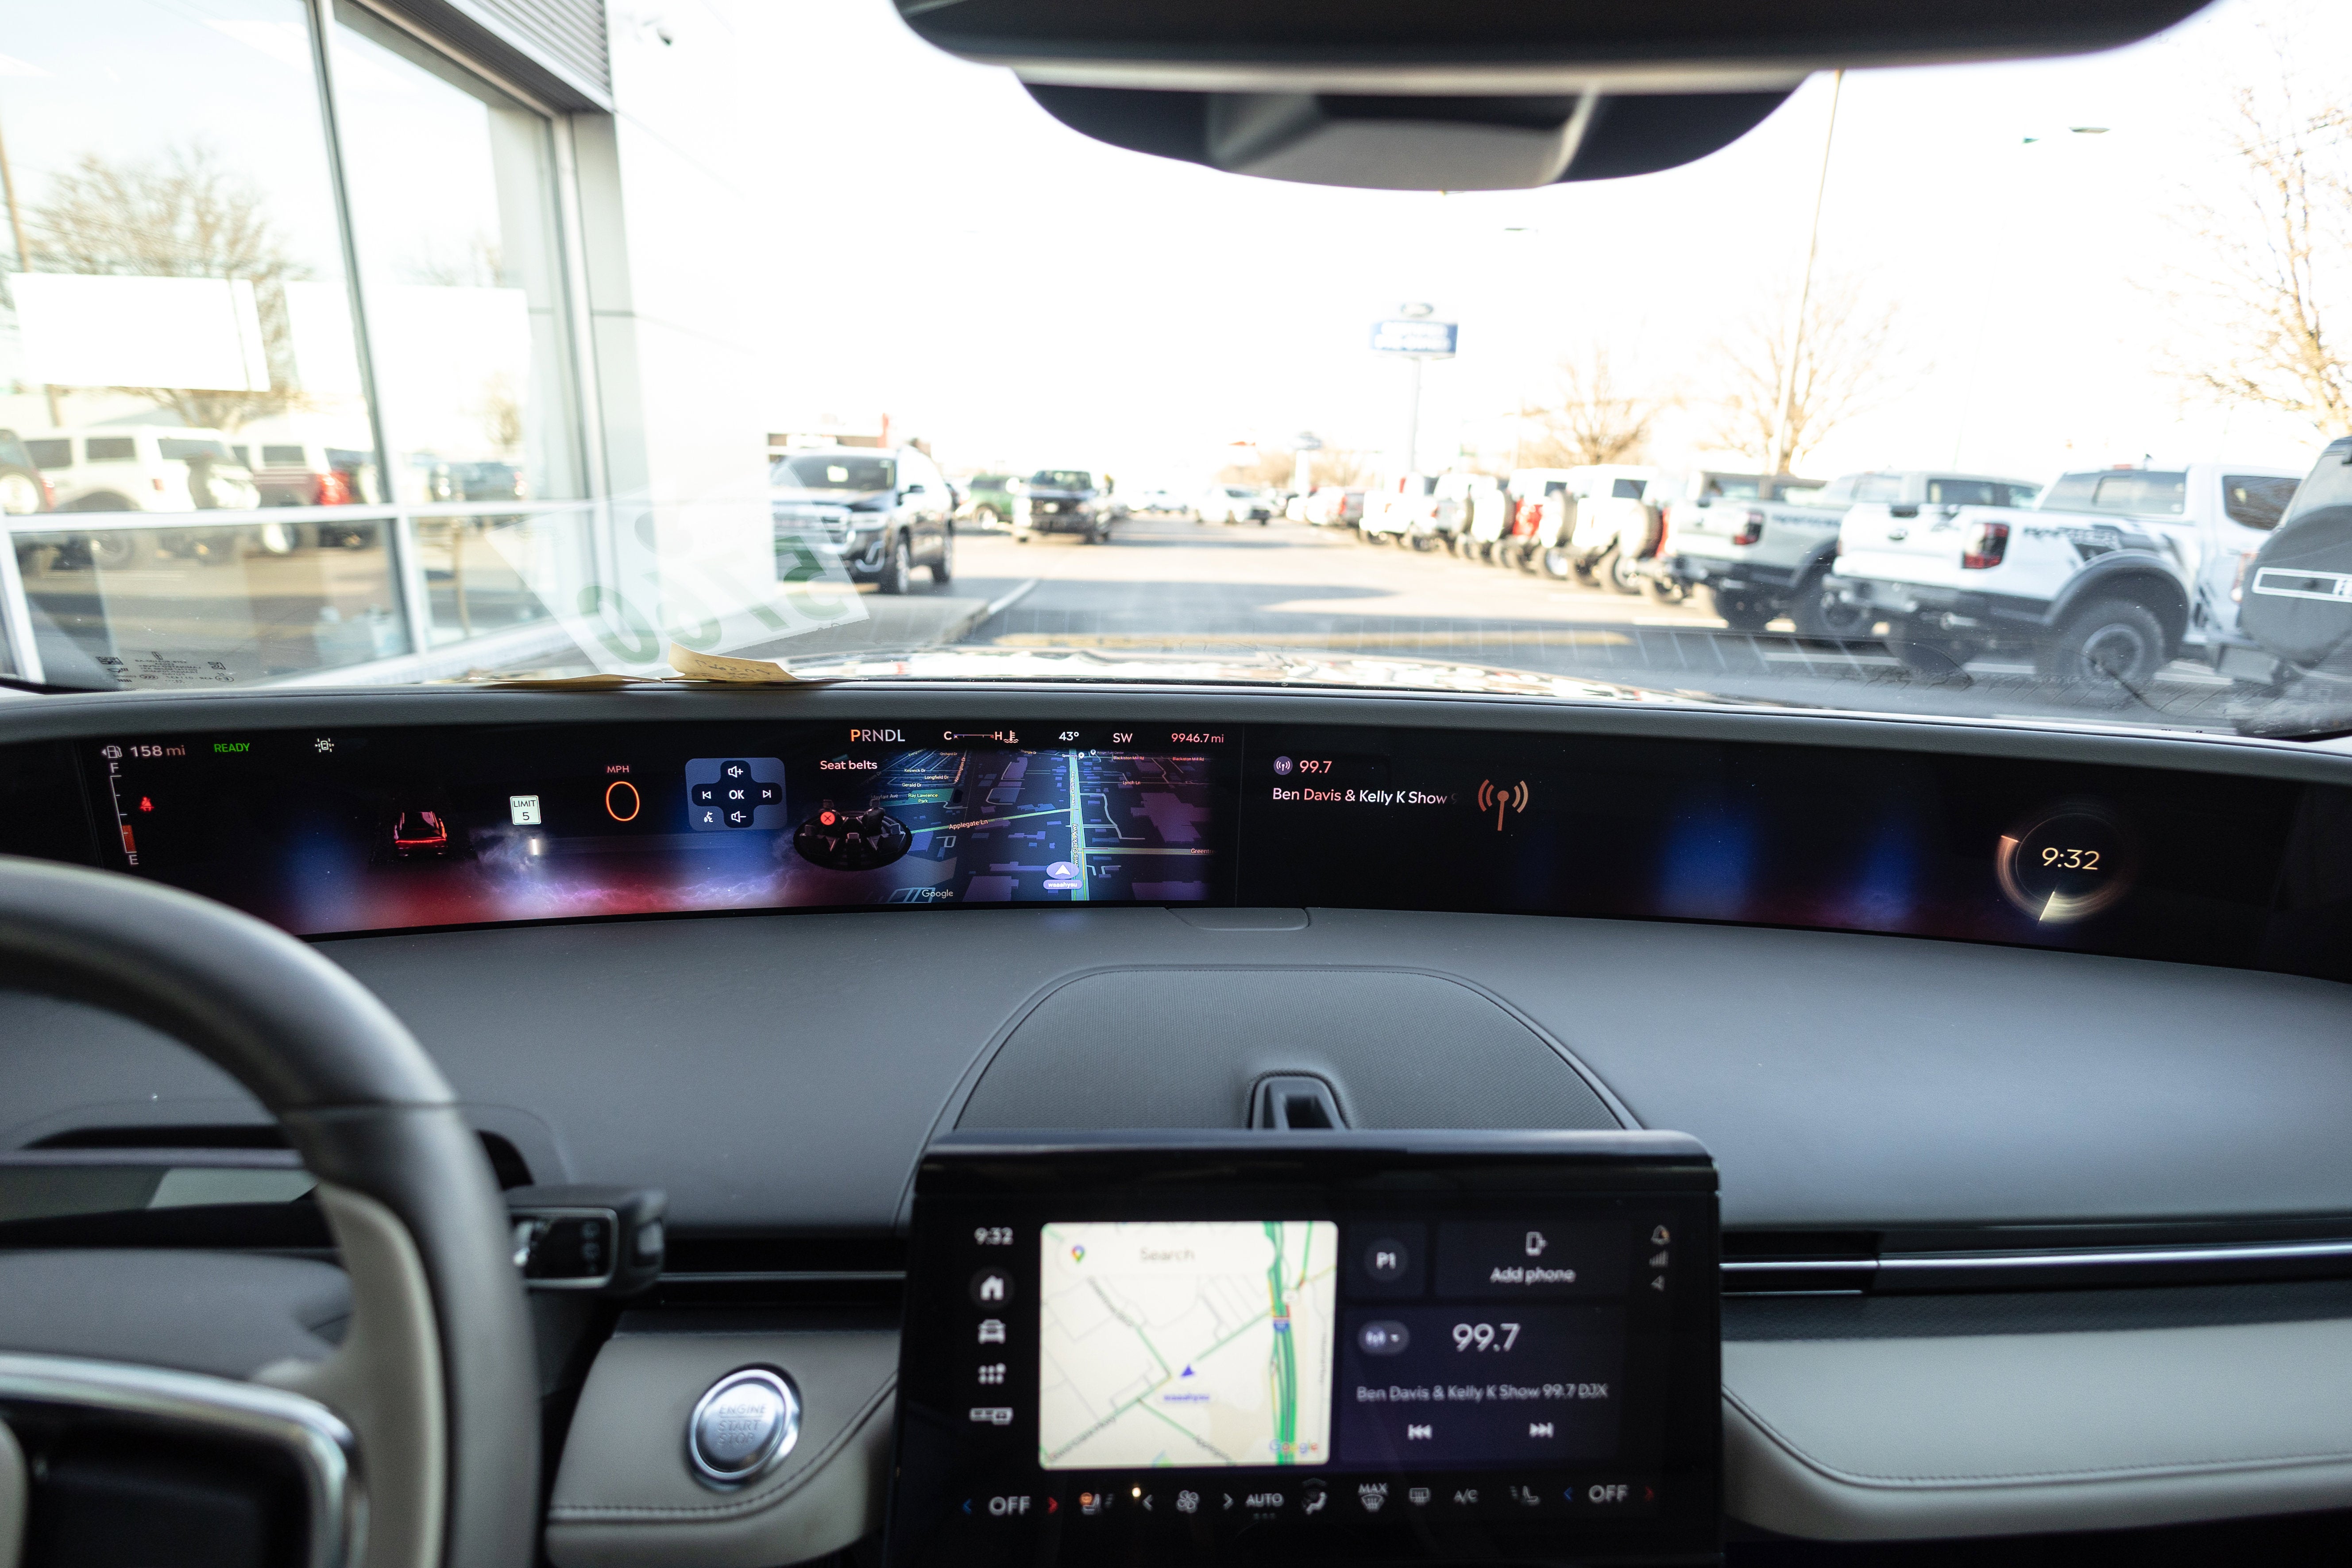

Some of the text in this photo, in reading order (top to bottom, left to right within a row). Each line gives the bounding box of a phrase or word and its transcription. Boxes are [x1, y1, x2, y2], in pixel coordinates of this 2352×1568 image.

[943, 731, 952, 741] C
[995, 731, 1002, 741] H
[1113, 733, 1133, 743] SW
[1171, 733, 1224, 743] 9946.7 mi
[130, 745, 186, 757] 158 mi
[214, 742, 250, 753] READY
[110, 763, 119, 773] F
[606, 765, 630, 773] MPH
[820, 760, 877, 770] Seat belts
[1299, 760, 1332, 773] 99.7
[606, 781, 640, 821] 0
[729, 790, 745, 800] OK
[1272, 787, 1300, 800] Ben
[1304, 788, 1341, 802] Davis
[1345, 790, 1356, 802] &
[1359, 790, 1393, 806] Kelly
[1396, 791, 1406, 803] K
[1408, 791, 1447, 804] Show
[522, 811, 530, 821] 5
[949, 821, 979, 830] Applegate
[129, 854, 139, 865] E
[2042, 847, 2100, 870] 9:32
[922, 888, 954, 899] Google
[974, 1227, 1014, 1245] 9:32
[1490, 1267, 1577, 1286] Add phone
[1452, 1322, 1521, 1352] 99.7
[1356, 1386, 1387, 1402] Ben
[1389, 1385, 1430, 1402] Davis
[1447, 1385, 1484, 1403] Kelly
[1486, 1384, 1497, 1400] K
[1498, 1383, 1541, 1400] Show
[1541, 1383, 1576, 1399] 99.7
[718, 1403, 767, 1416] ENGINE
[717, 1418, 762, 1433] START
[716, 1433, 755, 1446] STOP
[1357, 1483, 1389, 1495] MAX
[1588, 1484, 1630, 1503] OFF
[1245, 1493, 1284, 1507] AUTO
[1453, 1489, 1479, 1503] A/C
[988, 1495, 1031, 1516] OFF
